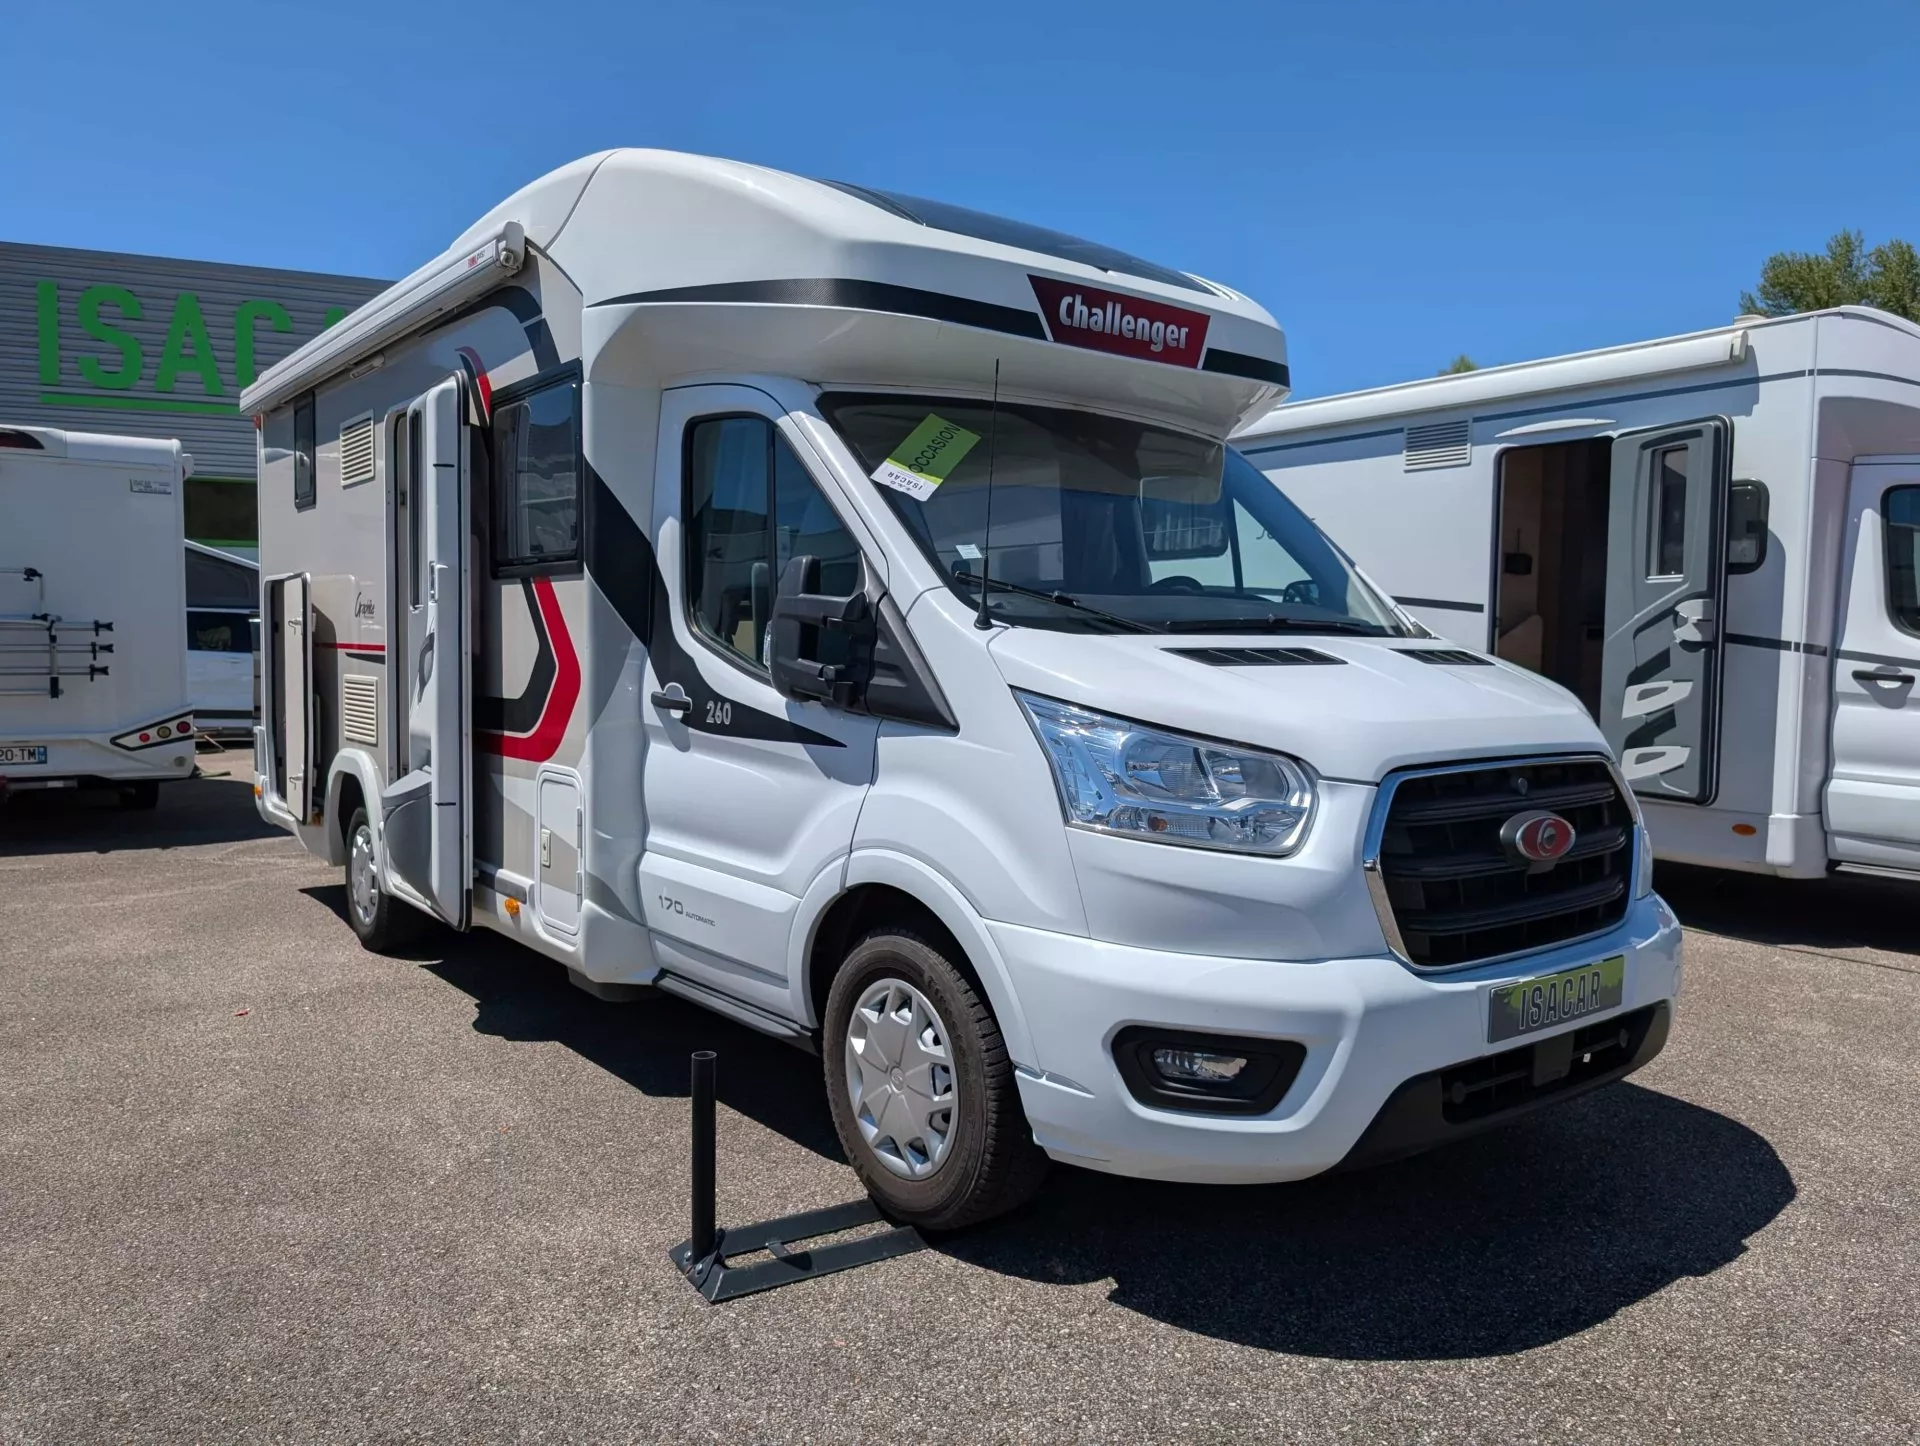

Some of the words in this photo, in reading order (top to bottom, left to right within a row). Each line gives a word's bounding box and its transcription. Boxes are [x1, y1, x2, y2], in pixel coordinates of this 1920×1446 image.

[37, 280, 346, 396] ISAC
[1058, 294, 1189, 352] Challenger
[908, 424, 961, 473] OCCASION
[888, 471, 923, 491] ISACAR
[706, 700, 731, 725] 260
[658, 895, 683, 915] 170
[685, 911, 716, 927] AUTOMATIC
[1520, 972, 1601, 1029] ISACAR
